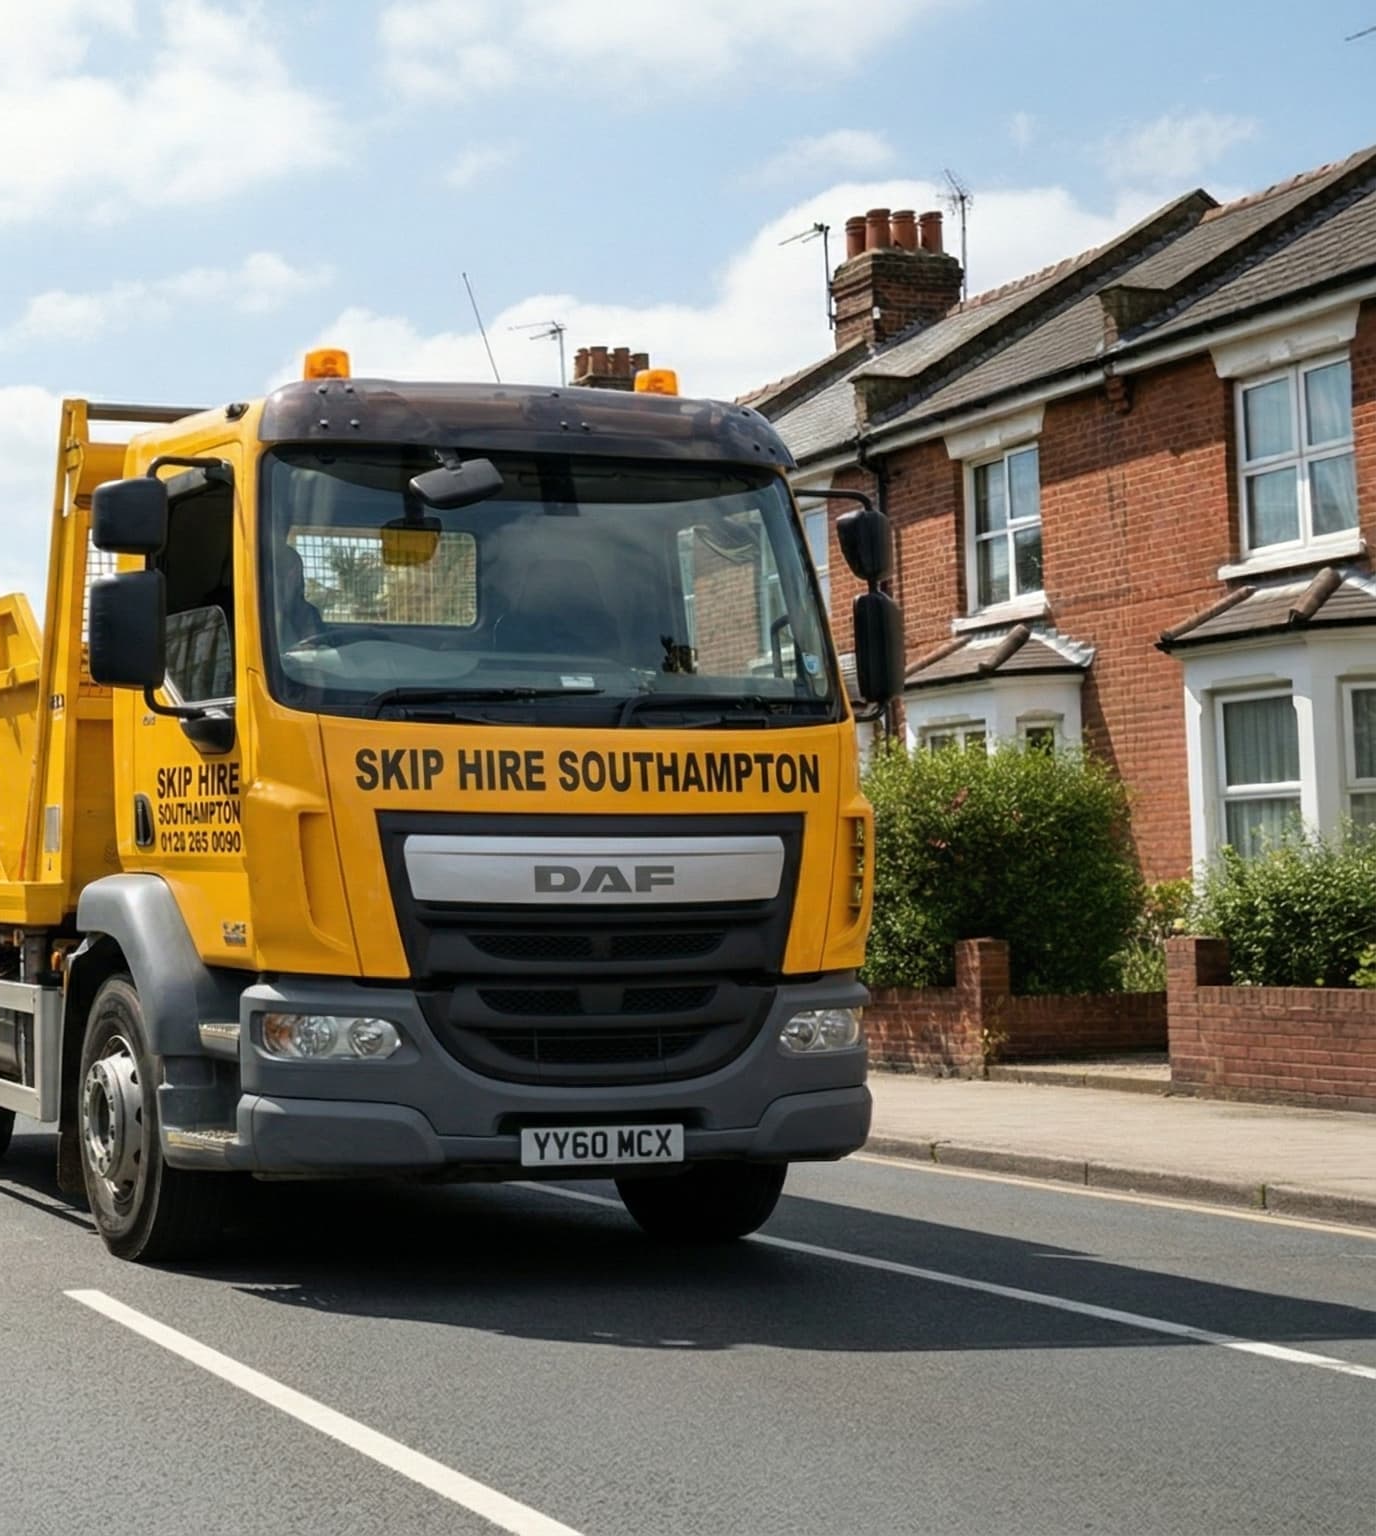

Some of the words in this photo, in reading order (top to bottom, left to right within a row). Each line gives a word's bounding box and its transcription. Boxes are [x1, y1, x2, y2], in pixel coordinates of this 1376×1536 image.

[157, 766, 193, 799] SKIP
[198, 762, 240, 796] HIRE
[355, 748, 444, 791] SKIP
[458, 749, 547, 792] HIRE
[558, 750, 820, 794] SOUTHAMPTON
[158, 800, 241, 825] SOUTHAMPTON
[211, 830, 241, 853] 0090
[534, 865, 675, 893] DAF
[533, 1131, 608, 1160] YY60
[617, 1128, 672, 1158] MCX
